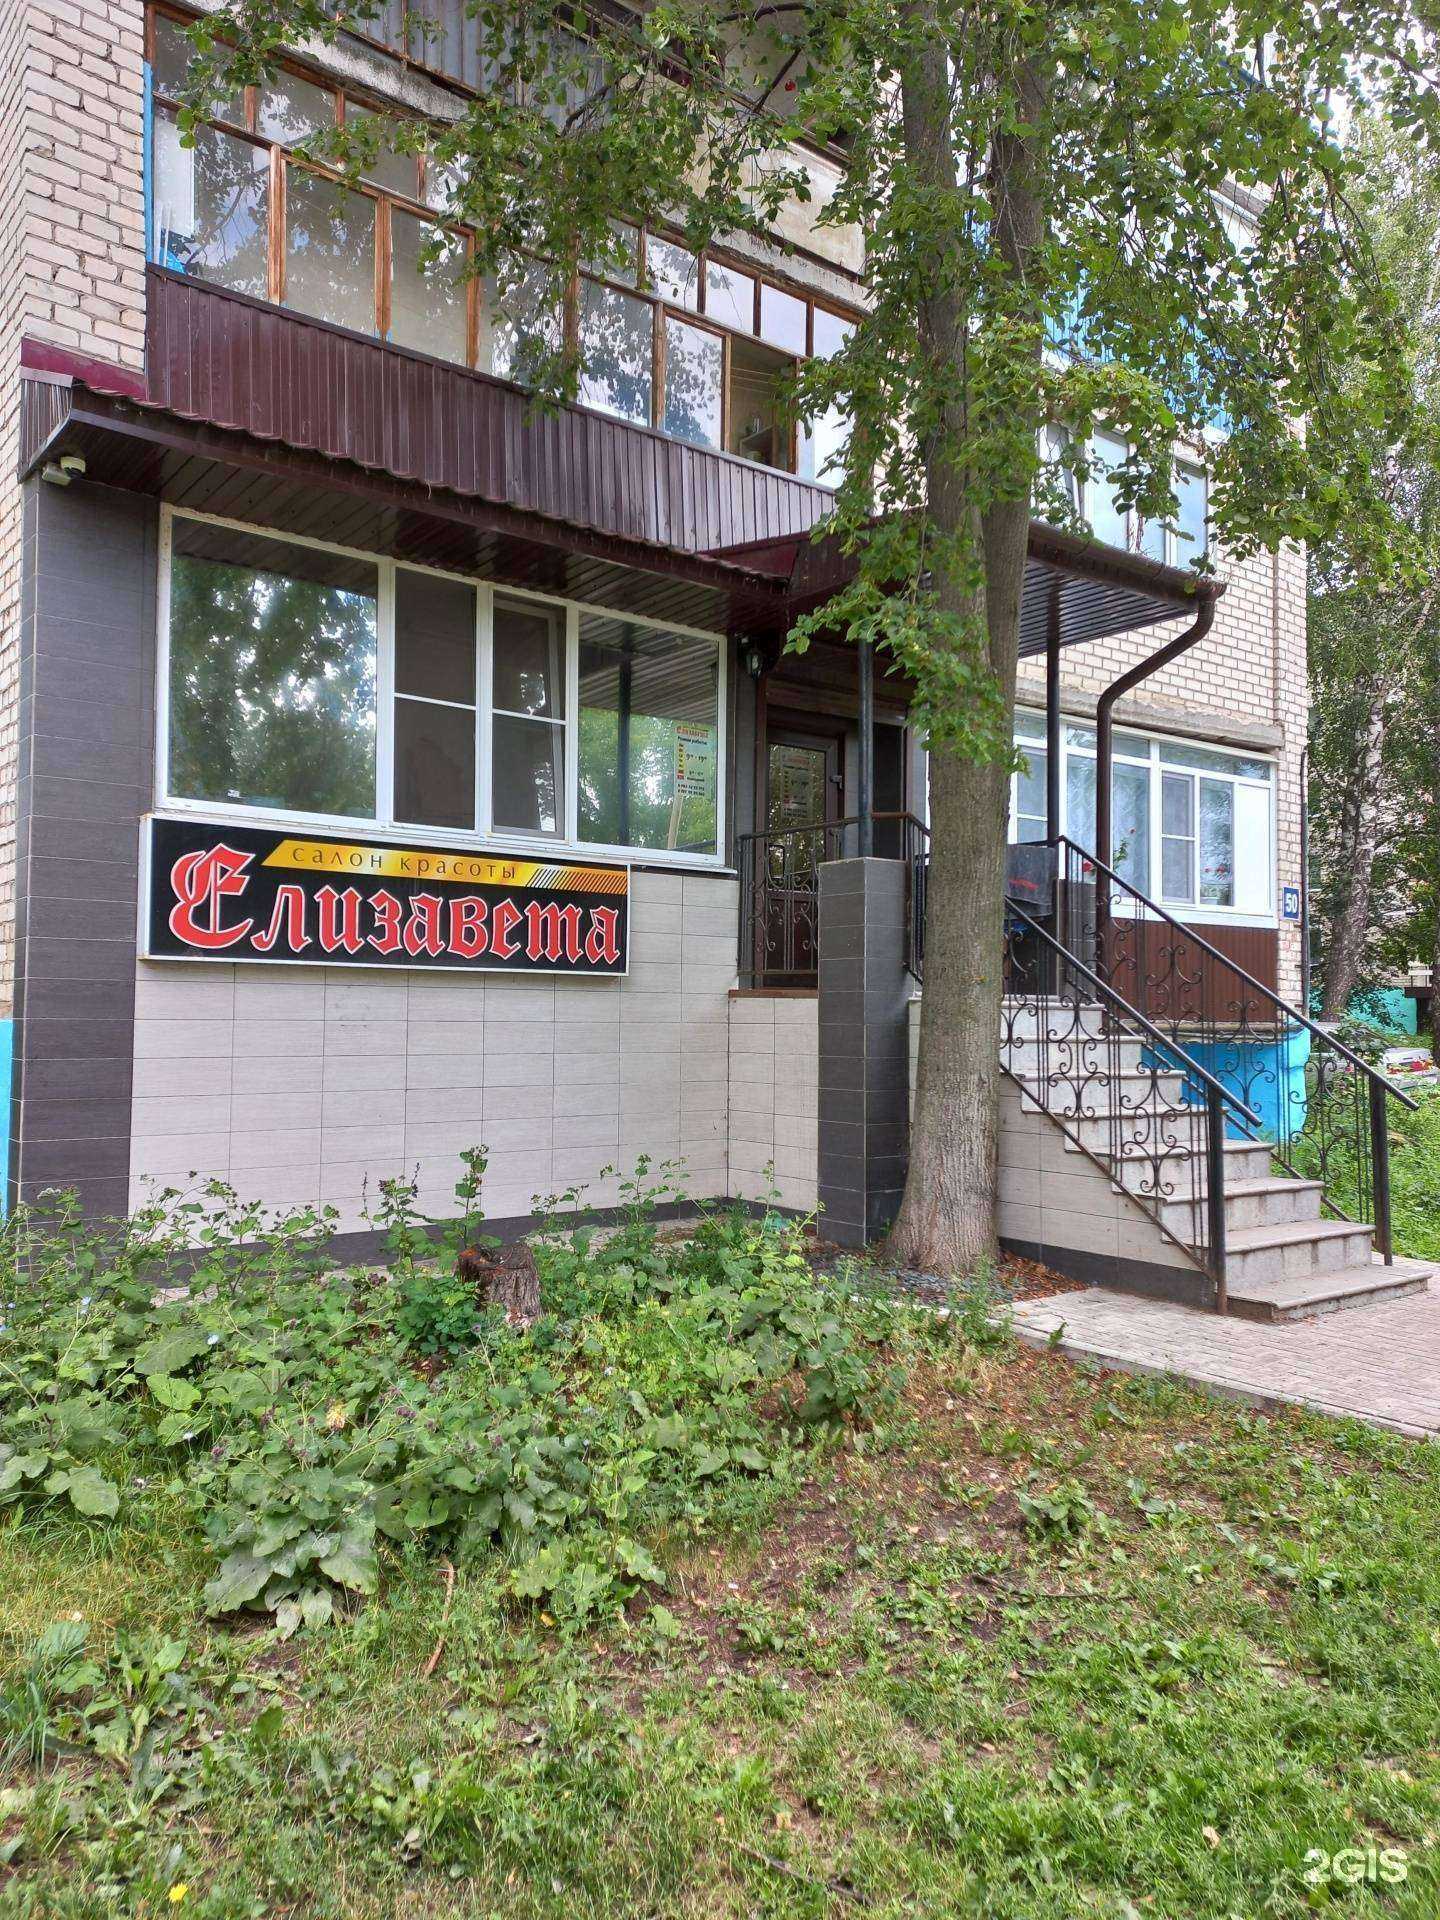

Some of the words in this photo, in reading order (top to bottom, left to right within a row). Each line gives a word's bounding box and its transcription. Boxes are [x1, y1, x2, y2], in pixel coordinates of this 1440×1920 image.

[292, 847, 382, 869] салон
[400, 857, 516, 879] красоты
[169, 842, 620, 963] Елизавета
[1286, 892, 1298, 914] 50
